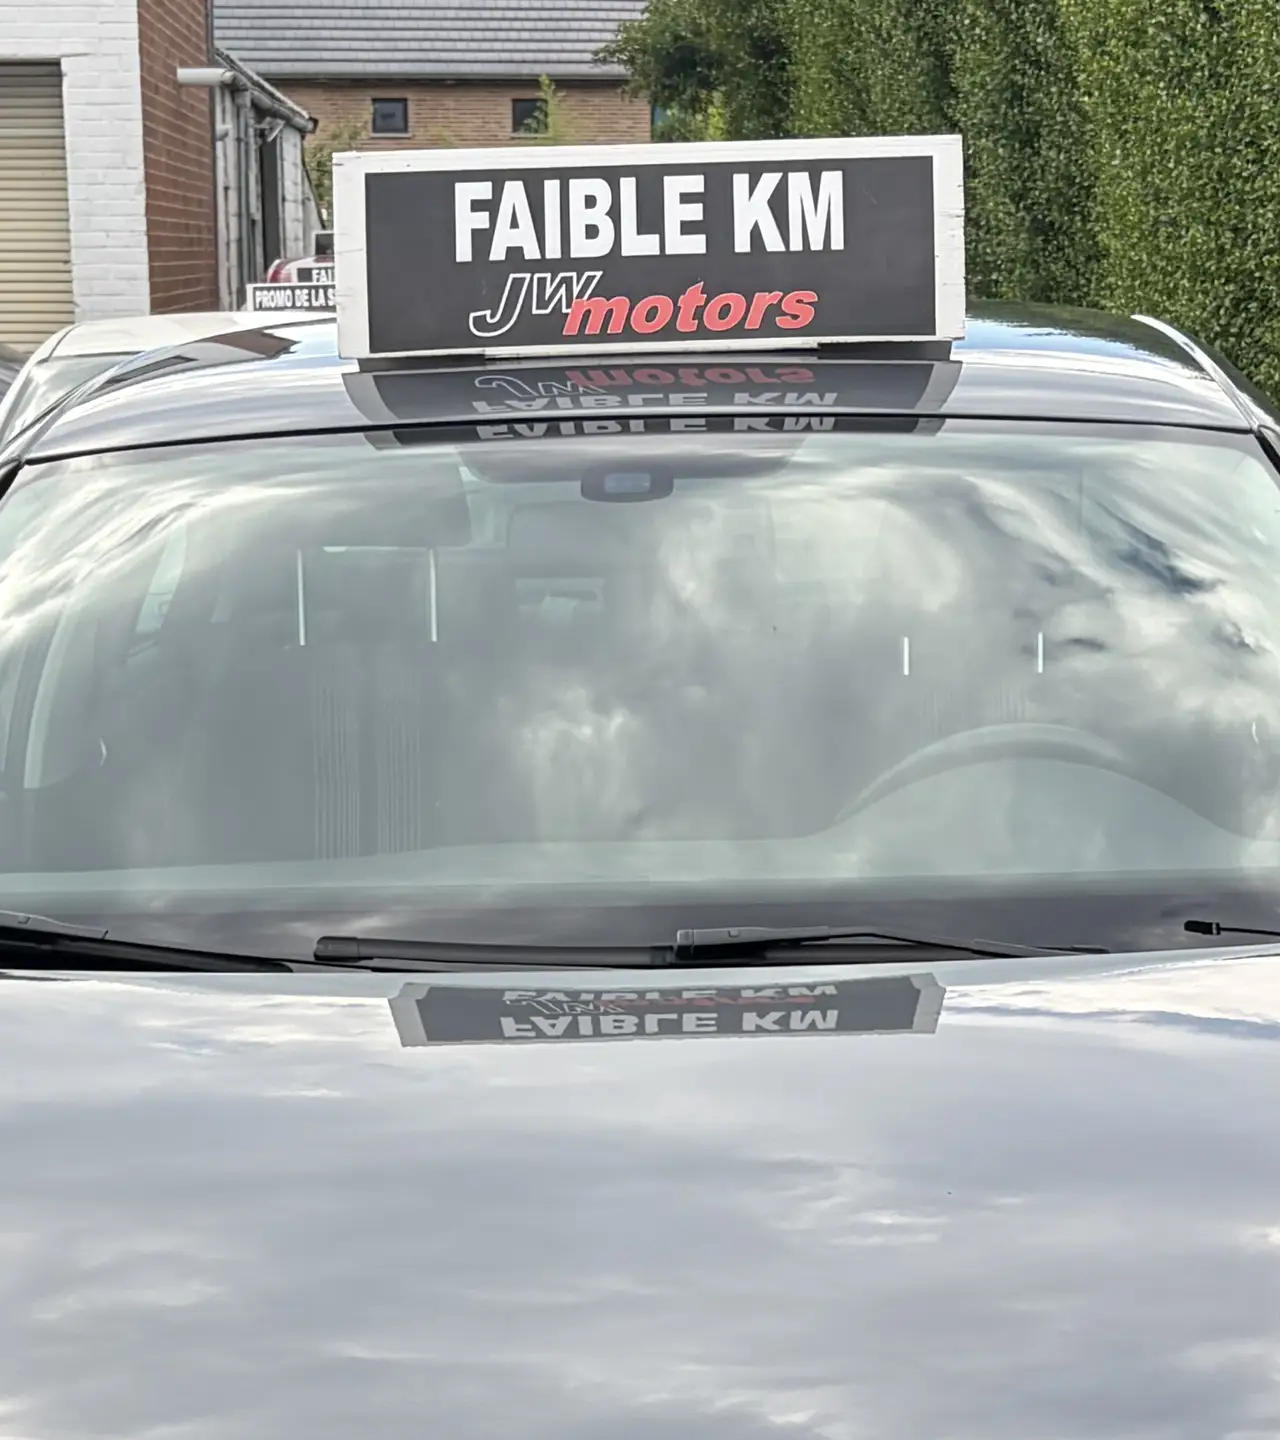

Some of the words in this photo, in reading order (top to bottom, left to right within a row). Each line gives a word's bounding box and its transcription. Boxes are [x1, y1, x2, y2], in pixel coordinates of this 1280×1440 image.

[454, 174, 707, 263] FAIBLE
[732, 170, 845, 254] KM
[255, 288, 294, 309] PROMO
[294, 288, 310, 307] DE
[310, 288, 326, 307] LA
[562, 280, 819, 336] motors
